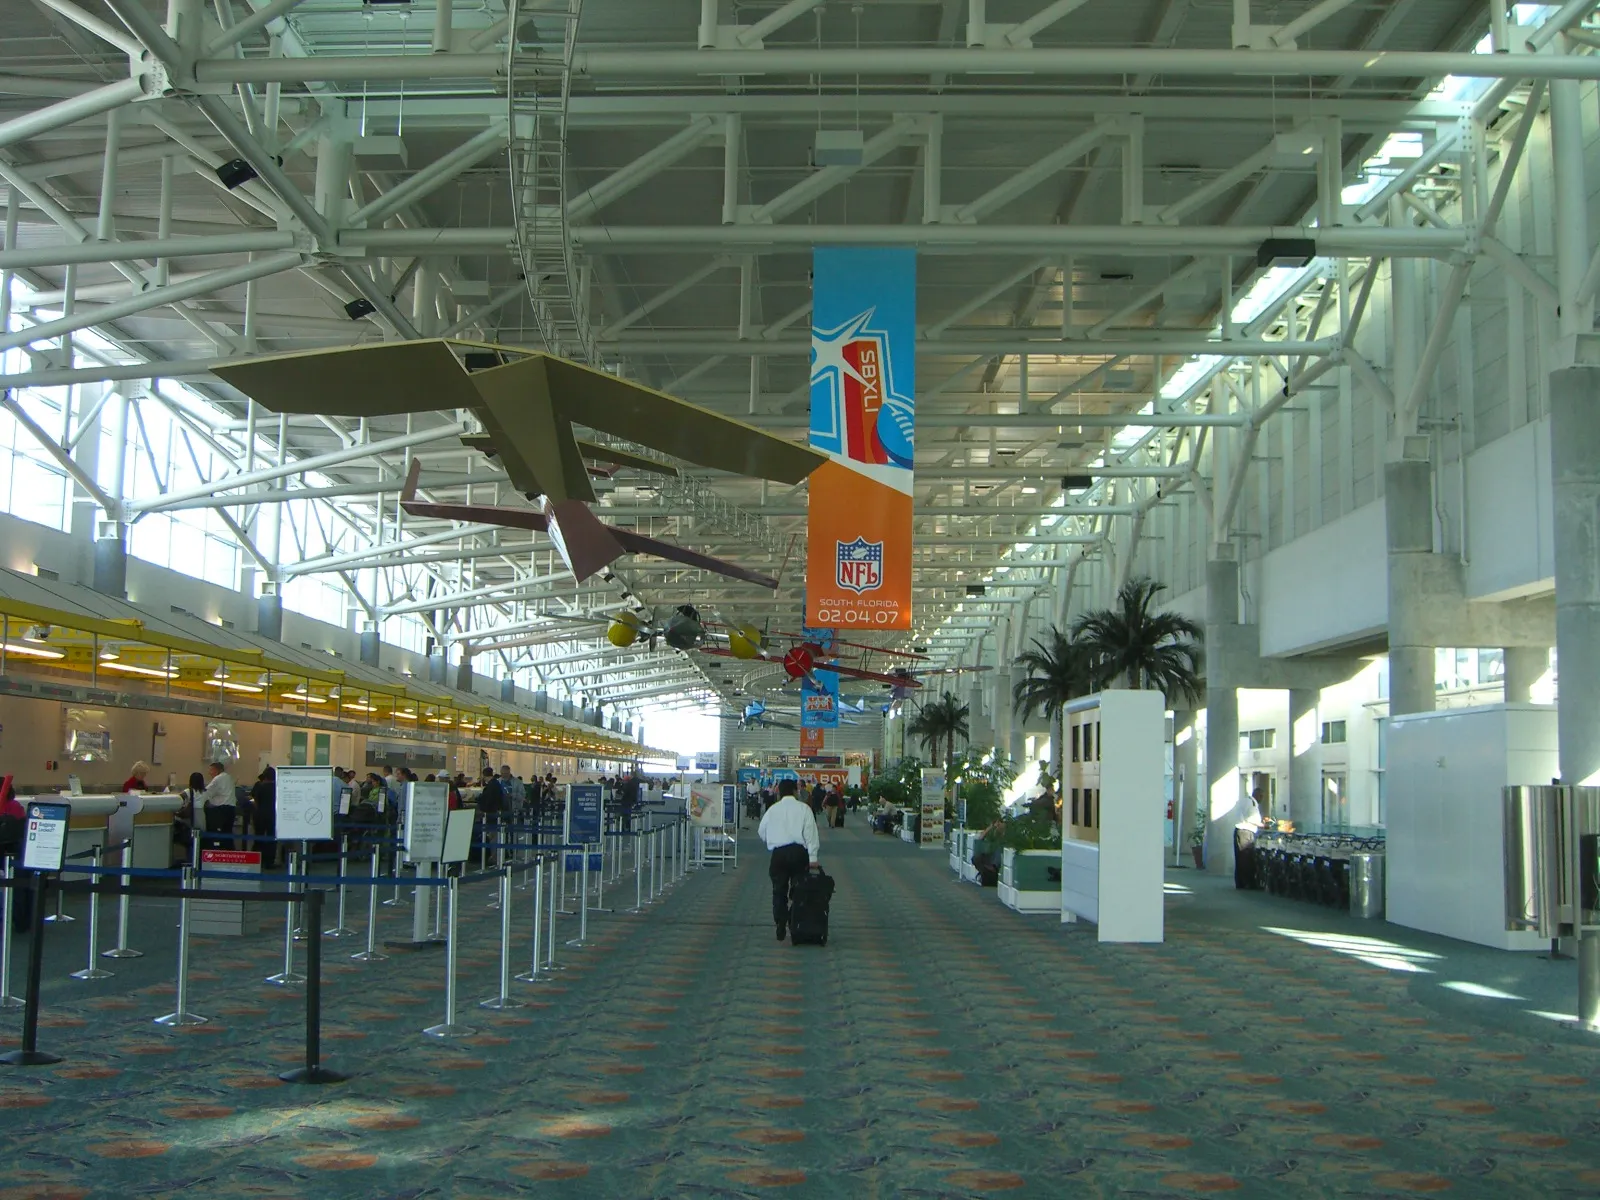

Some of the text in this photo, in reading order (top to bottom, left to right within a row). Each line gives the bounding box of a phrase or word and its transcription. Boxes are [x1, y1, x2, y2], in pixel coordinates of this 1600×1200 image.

[861, 350, 879, 412] SBXLI
[841, 562, 877, 587] NFL
[818, 610, 898, 624] 02.04.07
